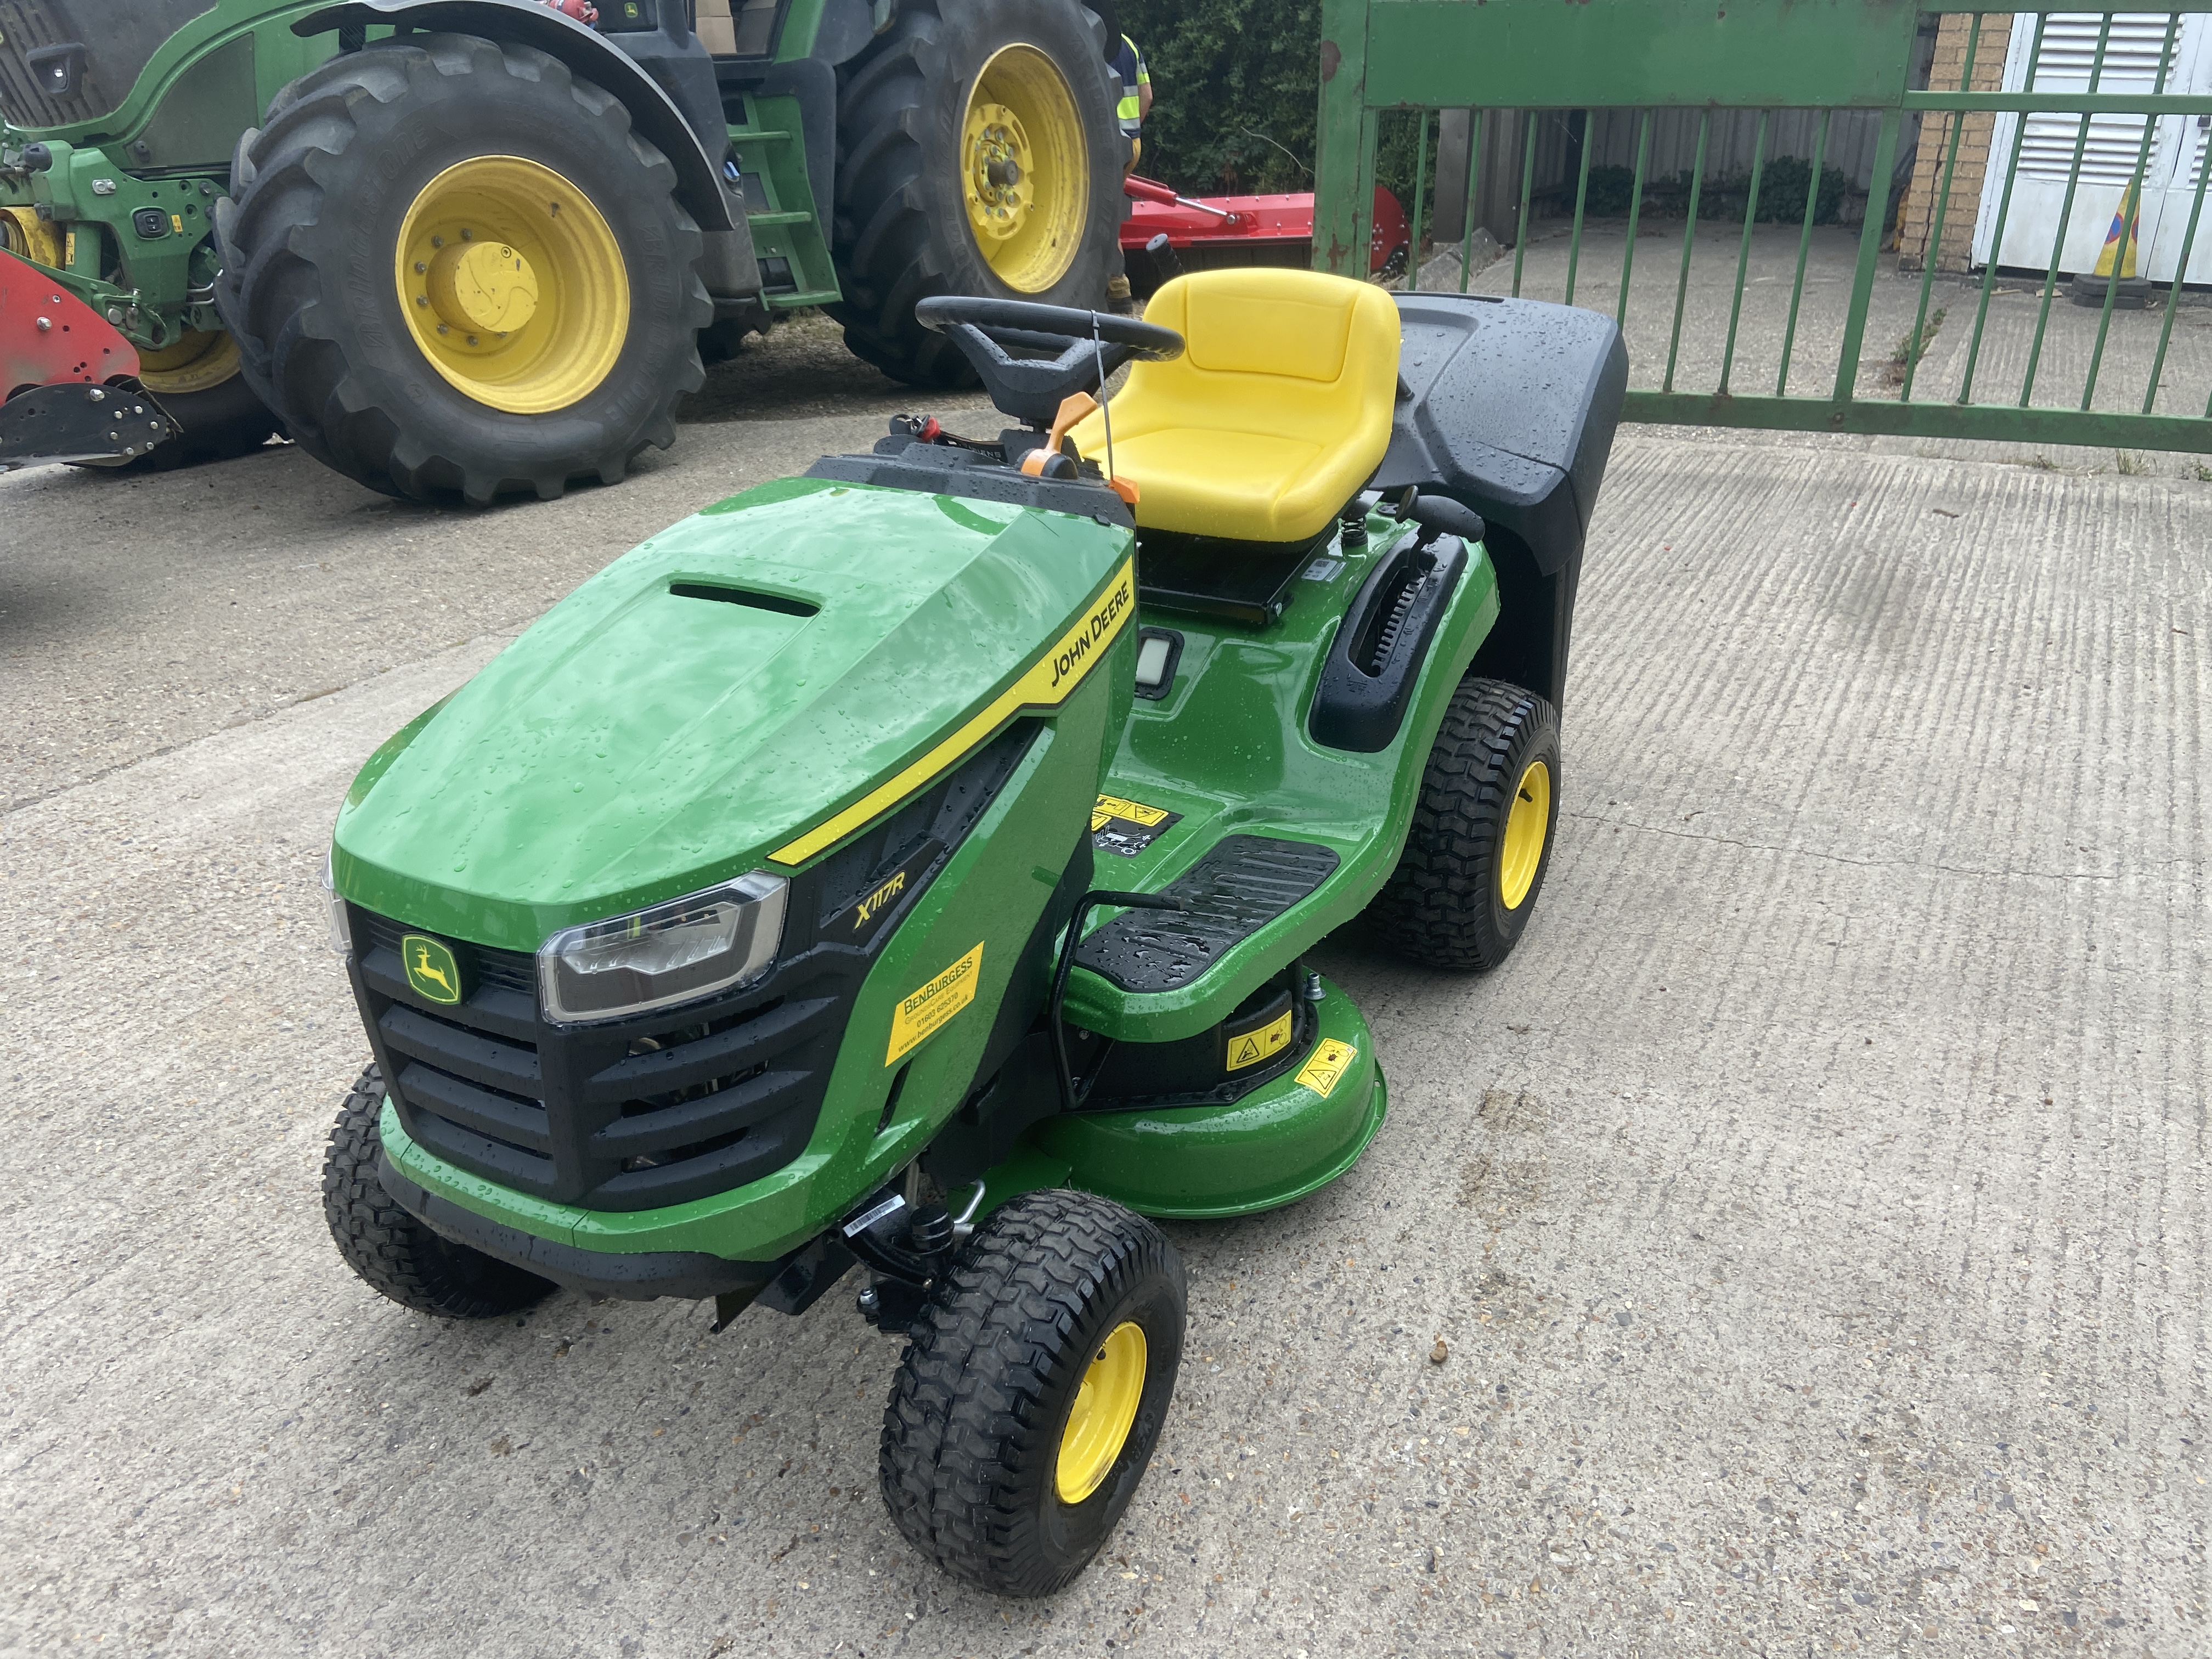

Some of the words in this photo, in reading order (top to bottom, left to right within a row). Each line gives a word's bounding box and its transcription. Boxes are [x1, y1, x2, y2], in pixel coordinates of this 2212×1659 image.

[1051, 630, 1091, 687] JOHN
[1091, 580, 1129, 642] DEERE
[854, 871, 905, 930] X117R
[898, 994, 969, 1052] www.benburgess.co.uk
[917, 1009, 936, 1028] 01603
[937, 992, 958, 1013] 625370
